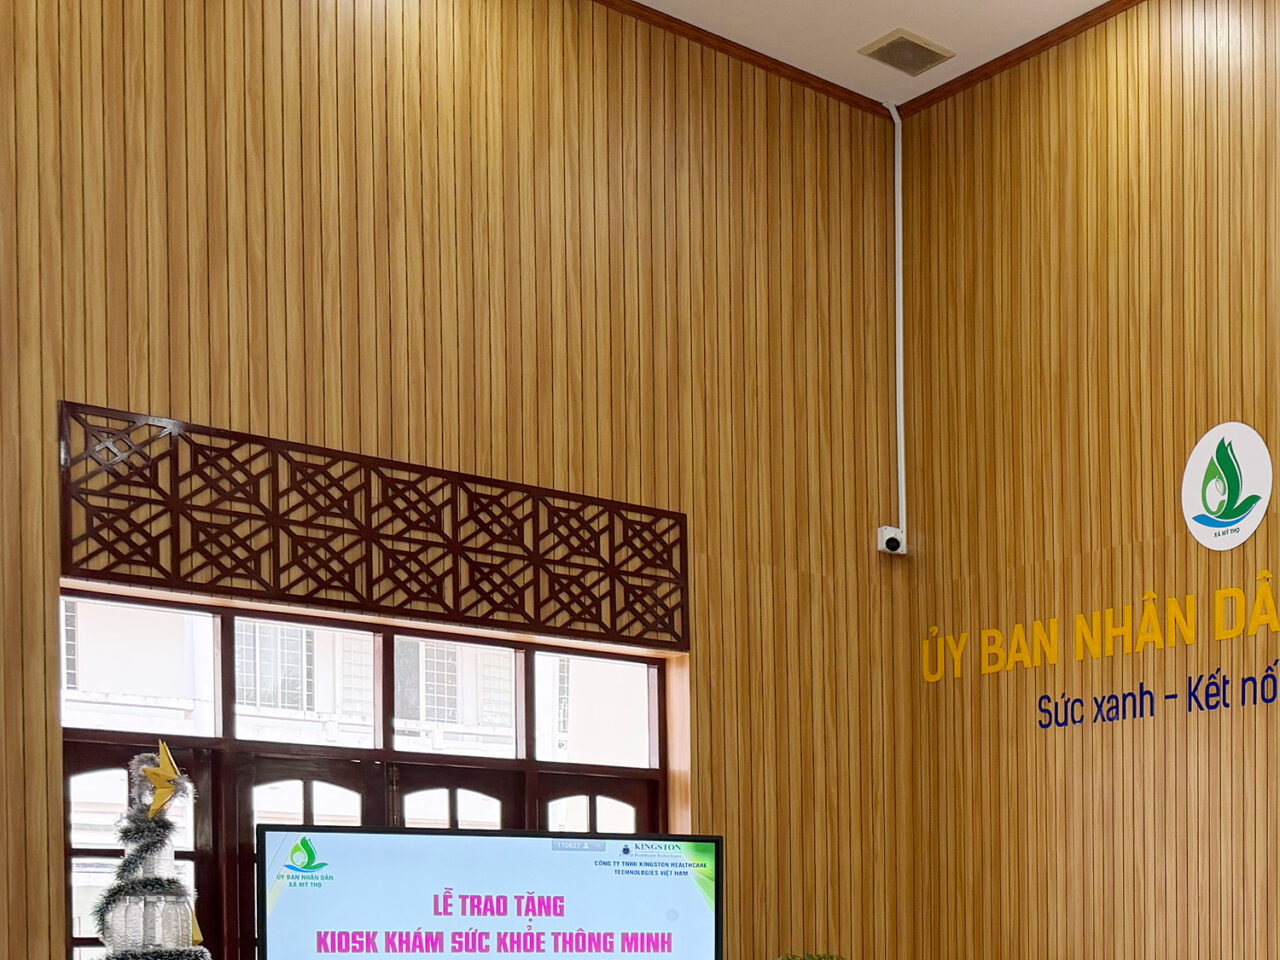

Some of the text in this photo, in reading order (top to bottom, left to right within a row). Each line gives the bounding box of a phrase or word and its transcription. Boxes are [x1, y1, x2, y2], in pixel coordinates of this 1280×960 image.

[921, 625, 968, 683] ỦY
[980, 617, 1059, 675] BAN
[1073, 592, 1196, 660] NHÂN
[1037, 688, 1085, 730] Sức
[1093, 680, 1155, 725] xanh
[1186, 670, 1231, 713] Kết
[634, 842, 682, 851] KINGSTON
[594, 858, 611, 867] CÔNG
[670, 861, 707, 869] HEALTHCARE
[660, 869, 673, 877] VIỆT
[433, 887, 565, 922] LỄ TRAO TẶNG
[316, 925, 673, 954] KIOSK KHÁM SỨC KHỎE THÔNG MINH
